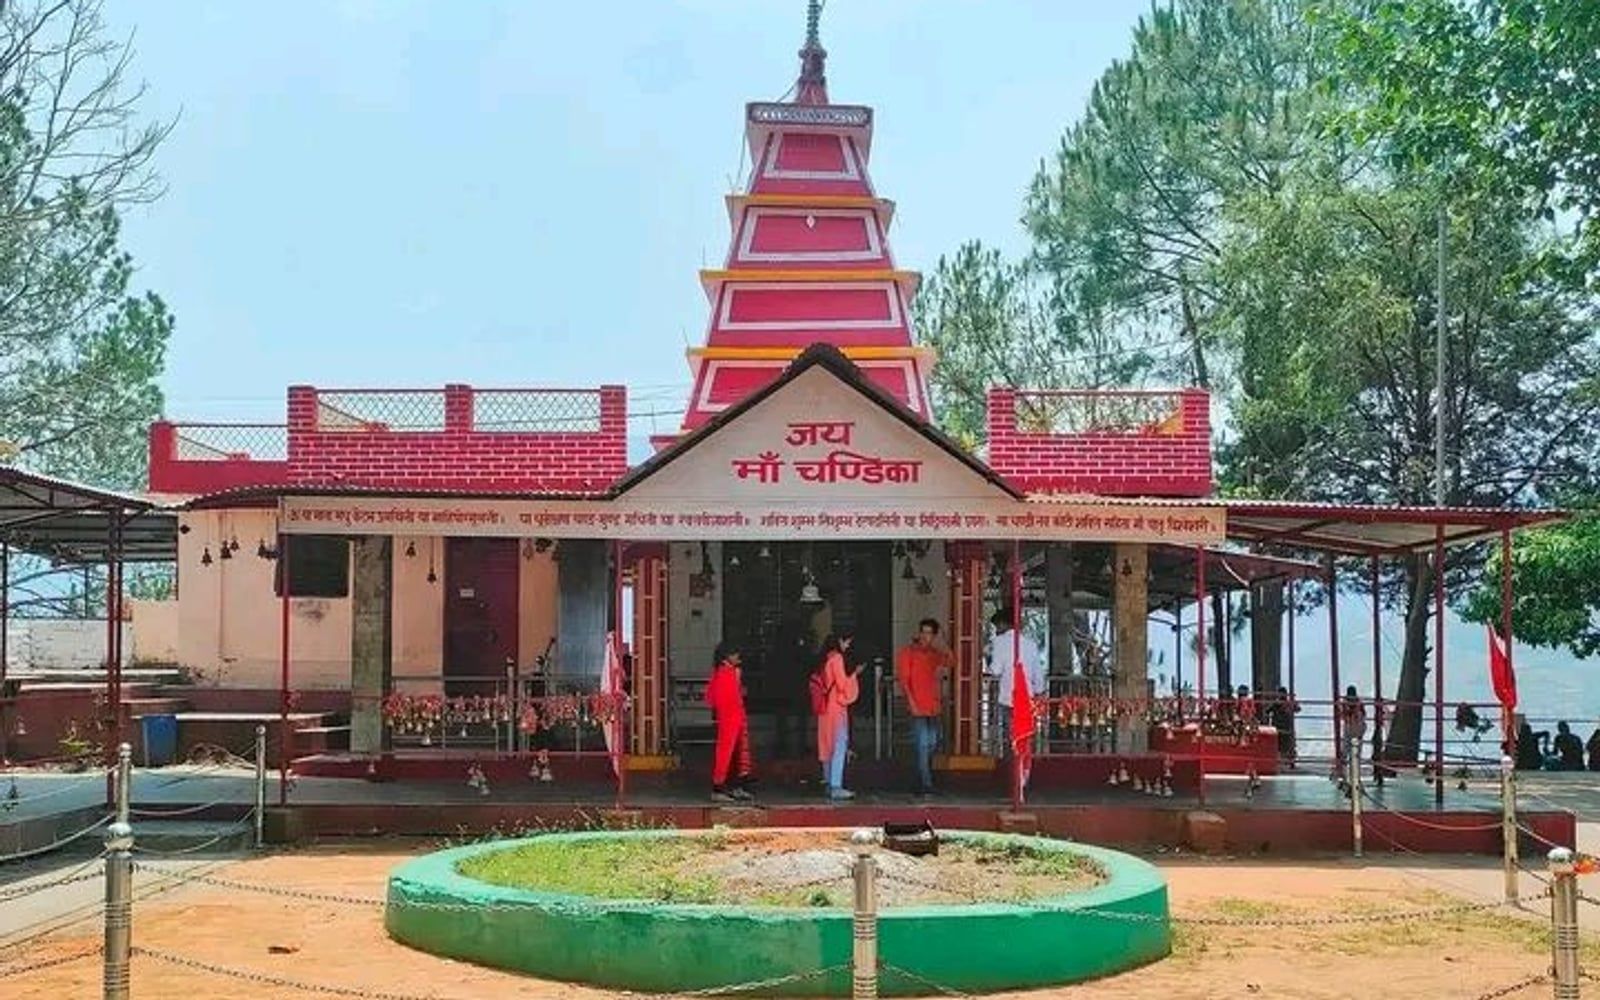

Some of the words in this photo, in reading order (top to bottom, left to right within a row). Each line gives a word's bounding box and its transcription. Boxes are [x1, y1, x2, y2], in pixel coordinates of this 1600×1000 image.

[785, 422, 854, 446] जय
[731, 451, 785, 483] माँ
[793, 450, 923, 484] चण्डिका
